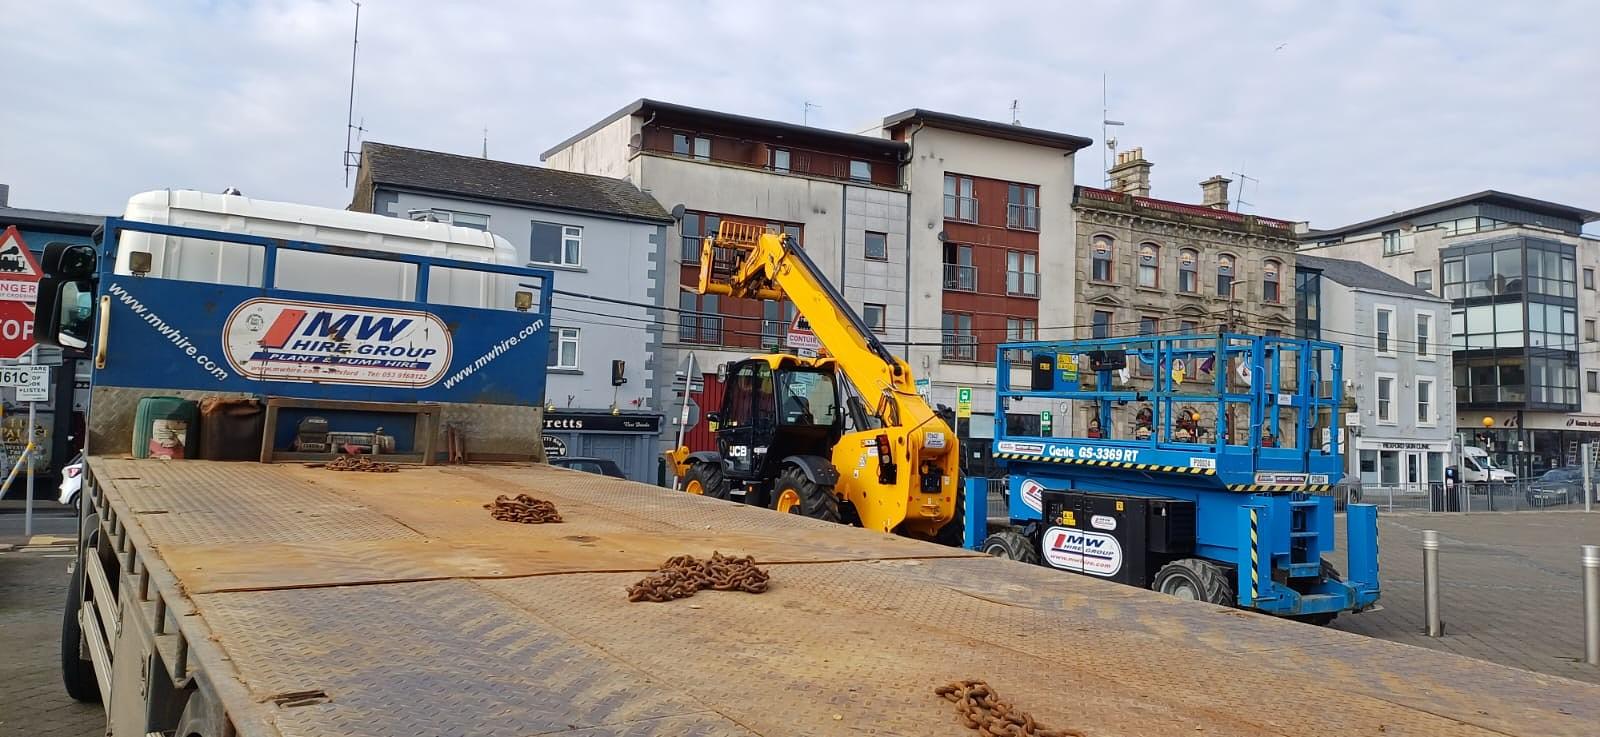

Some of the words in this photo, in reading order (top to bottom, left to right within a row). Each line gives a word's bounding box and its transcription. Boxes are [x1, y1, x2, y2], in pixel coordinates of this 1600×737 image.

[0, 319, 34, 341] OP
[108, 282, 229, 381] www.mwhire.com
[302, 311, 414, 342] MW
[292, 340, 352, 355] HIRE
[357, 343, 437, 359] GROUP
[442, 317, 544, 390] www.mwhire.com
[269, 353, 320, 362] PLANT
[338, 358, 382, 367] PUMP
[385, 361, 418, 369] HIRE
[729, 445, 747, 457] JCB
[1048, 445, 1074, 458] Genie
[1078, 446, 1122, 461] GS-3369
[1123, 450, 1139, 462] RT
[1063, 544, 1082, 552] HIRE
[1085, 548, 1115, 556] GROUP
[1066, 535, 1105, 548] MW
